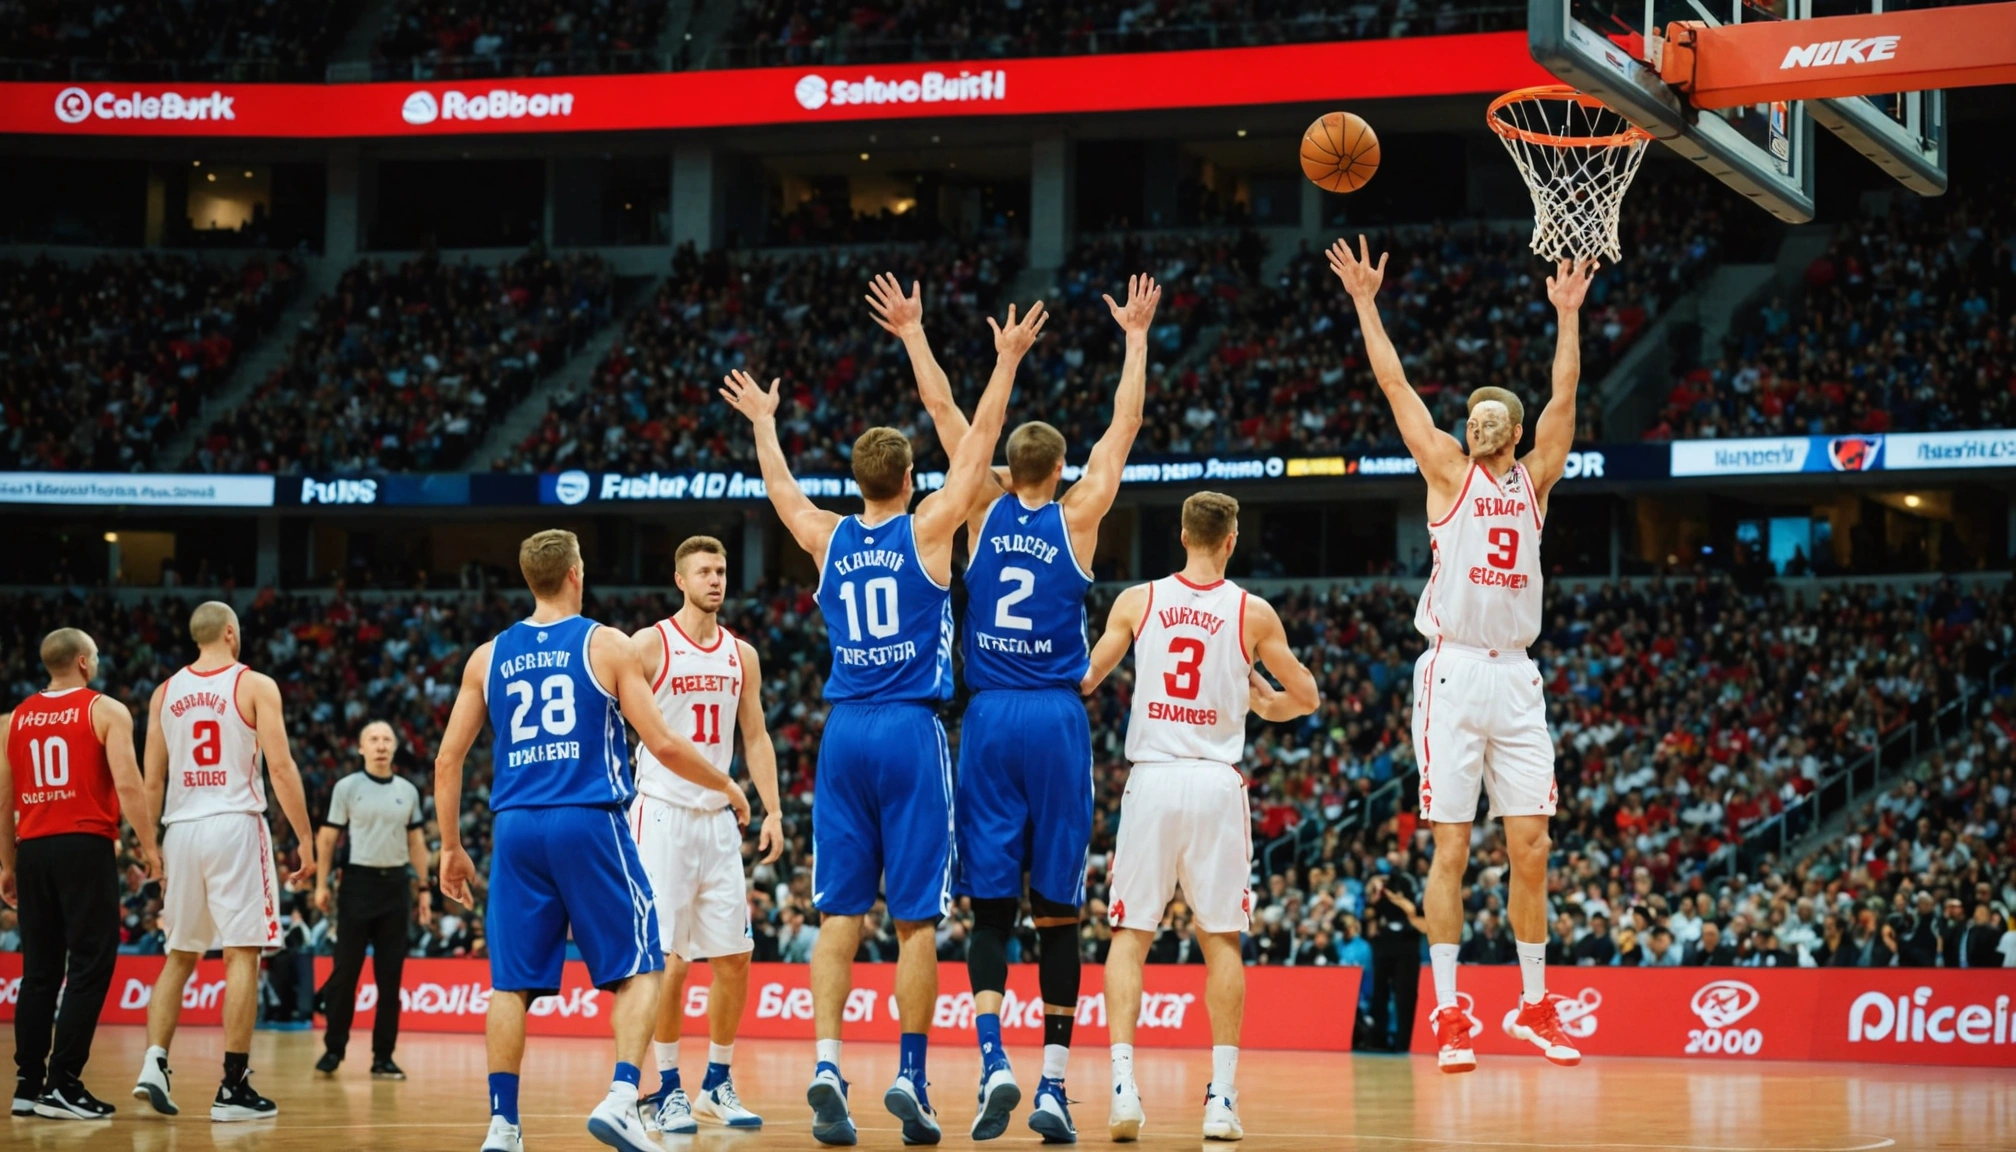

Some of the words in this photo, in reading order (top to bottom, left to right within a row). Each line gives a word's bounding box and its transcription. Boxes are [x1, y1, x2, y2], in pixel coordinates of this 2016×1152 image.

[839, 576, 899, 642] 10
[995, 566, 1035, 631] 2
[1163, 636, 1205, 701] 3
[506, 674, 577, 745] 28
[691, 703, 720, 745] 11
[29, 735, 69, 788] 10
[1684, 1029, 1763, 1055] 2000
